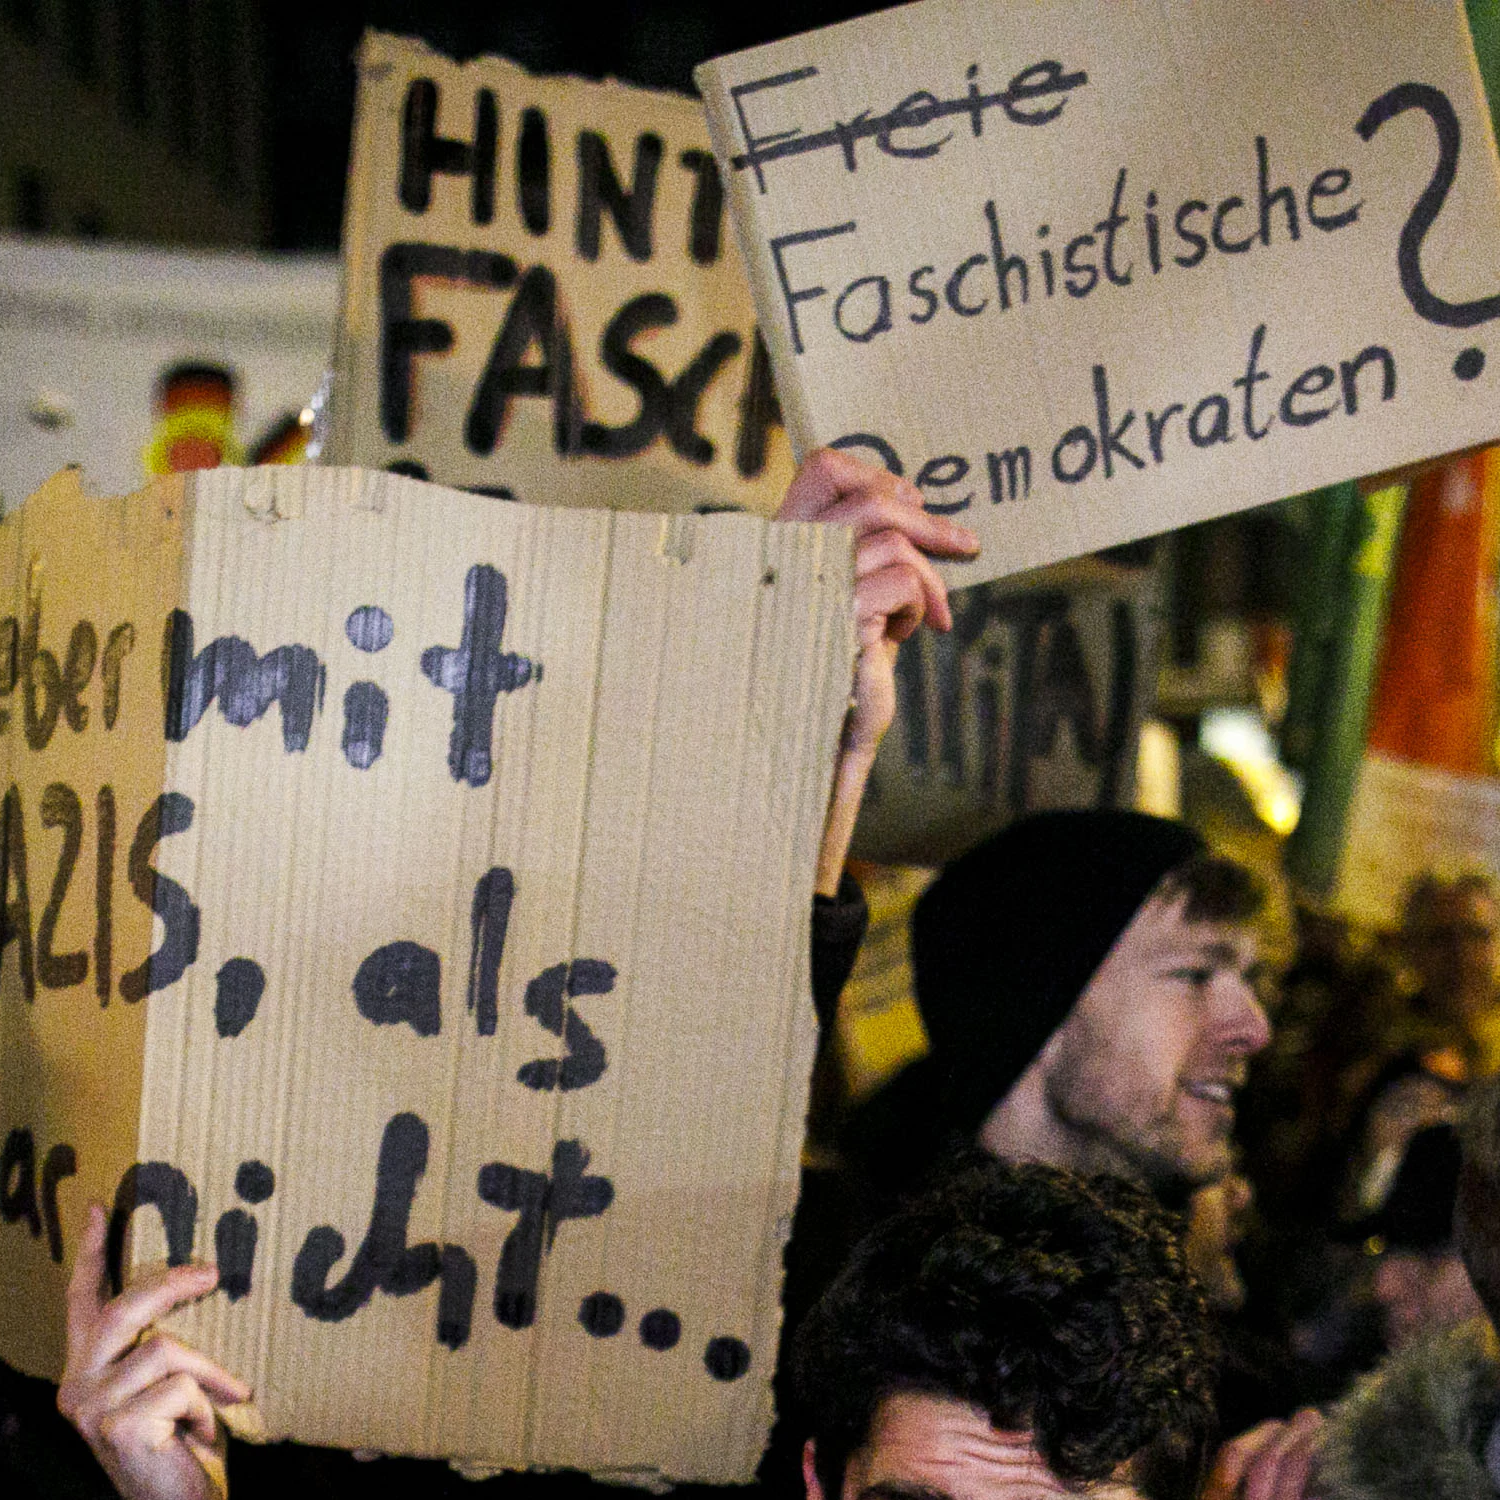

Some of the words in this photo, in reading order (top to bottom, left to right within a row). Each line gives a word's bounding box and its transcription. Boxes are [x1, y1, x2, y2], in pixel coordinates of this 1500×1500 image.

[731, 56, 1088, 194] Freie
[771, 136, 1364, 355] Faschistische
[163, 564, 543, 787] mit
[353, 866, 617, 1091] als
